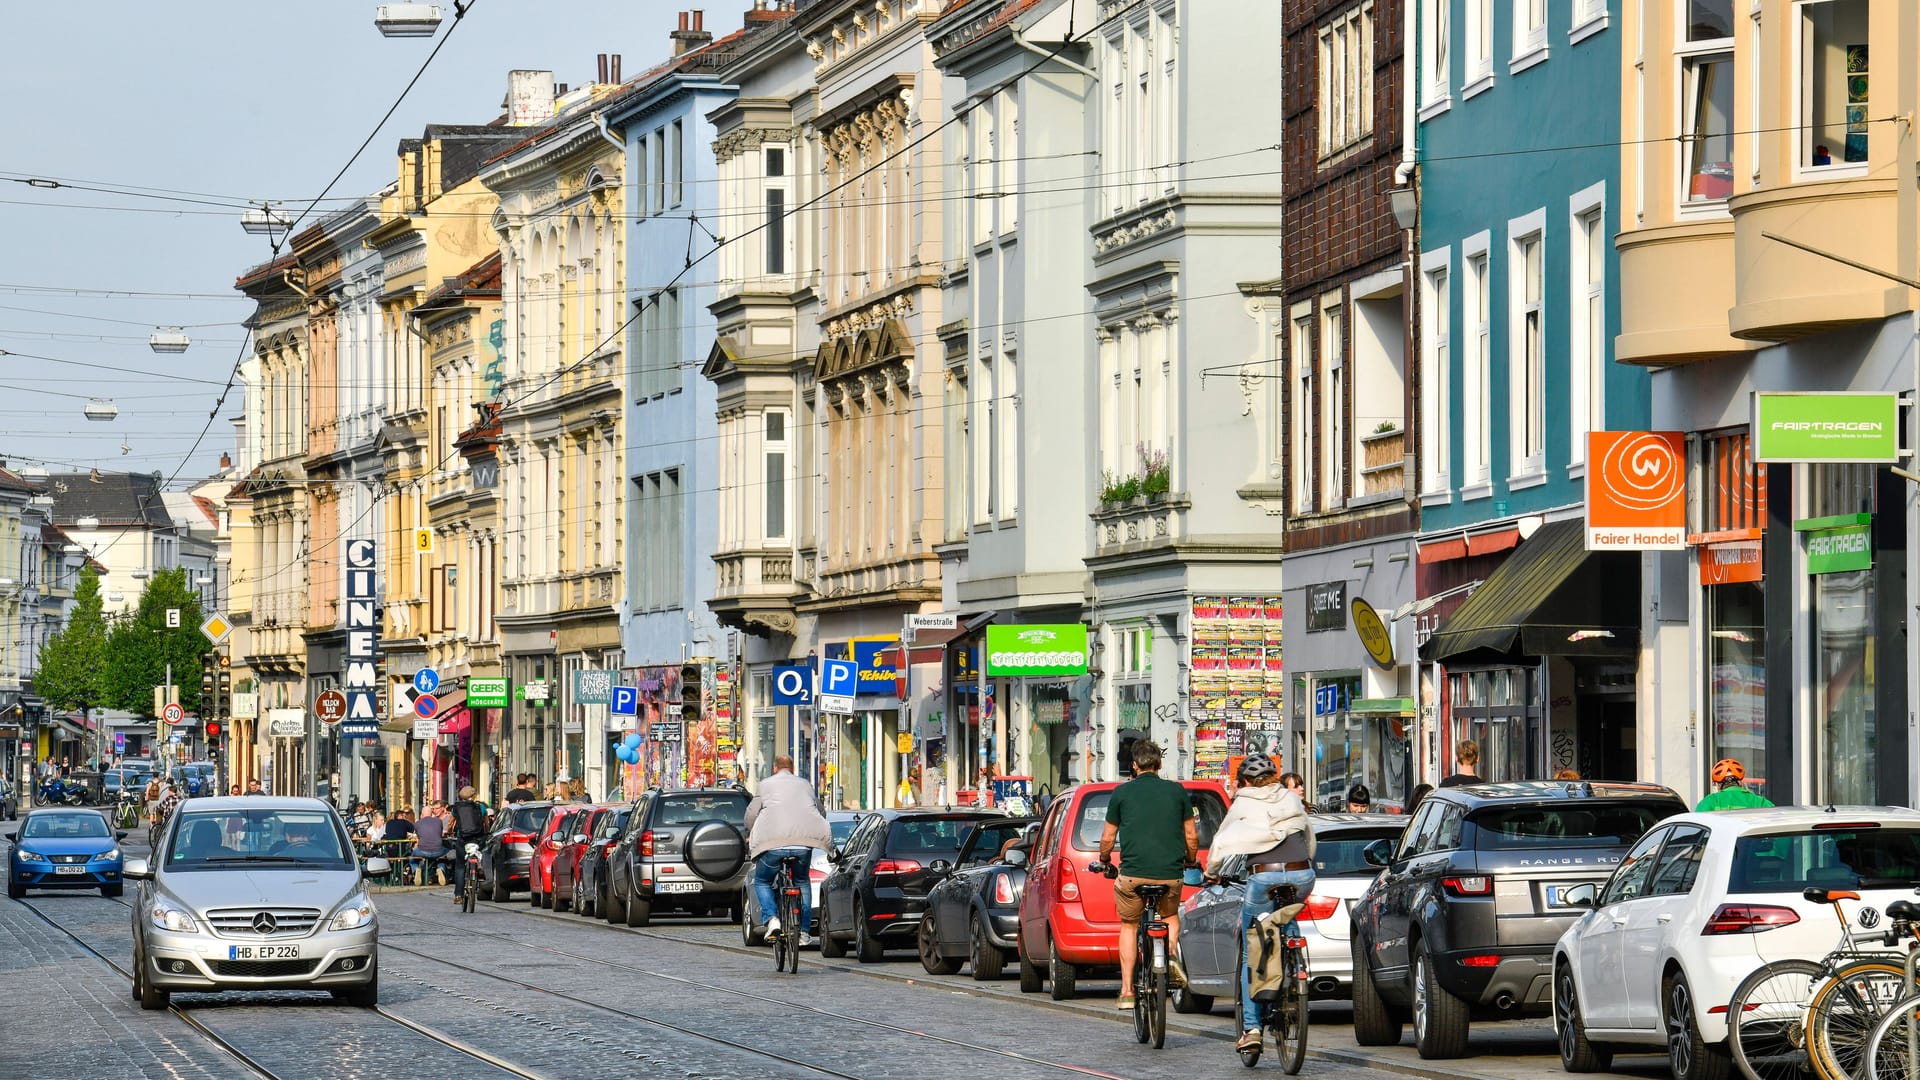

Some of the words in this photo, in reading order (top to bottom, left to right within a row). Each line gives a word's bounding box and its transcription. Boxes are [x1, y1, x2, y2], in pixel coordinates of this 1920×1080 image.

[1771, 422, 1882, 431] FAIRTRAGEN
[421, 534, 427, 547] 3
[1594, 532, 1630, 545] Fairer
[1634, 532, 1680, 545] Handel
[1808, 532, 1869, 556] FAIRTRAGEN
[1328, 590, 1341, 610] ME
[169, 612, 177, 625] E
[914, 617, 953, 626] Weberstraße
[347, 540, 376, 718] CINEMA
[829, 664, 849, 691] P
[858, 669, 897, 681] Tchibo
[471, 684, 505, 693] GEERS
[582, 680, 610, 688] UNGS
[617, 690, 631, 711] P
[167, 709, 179, 719] 30
[1245, 722, 1262, 731] HOT
[1520, 857, 1584, 865] RANGE
[675, 883, 685, 891] LH
[686, 883, 699, 891] 118
[237, 947, 252, 958] HB
[259, 946, 275, 958] EP
[277, 946, 298, 958] 226
